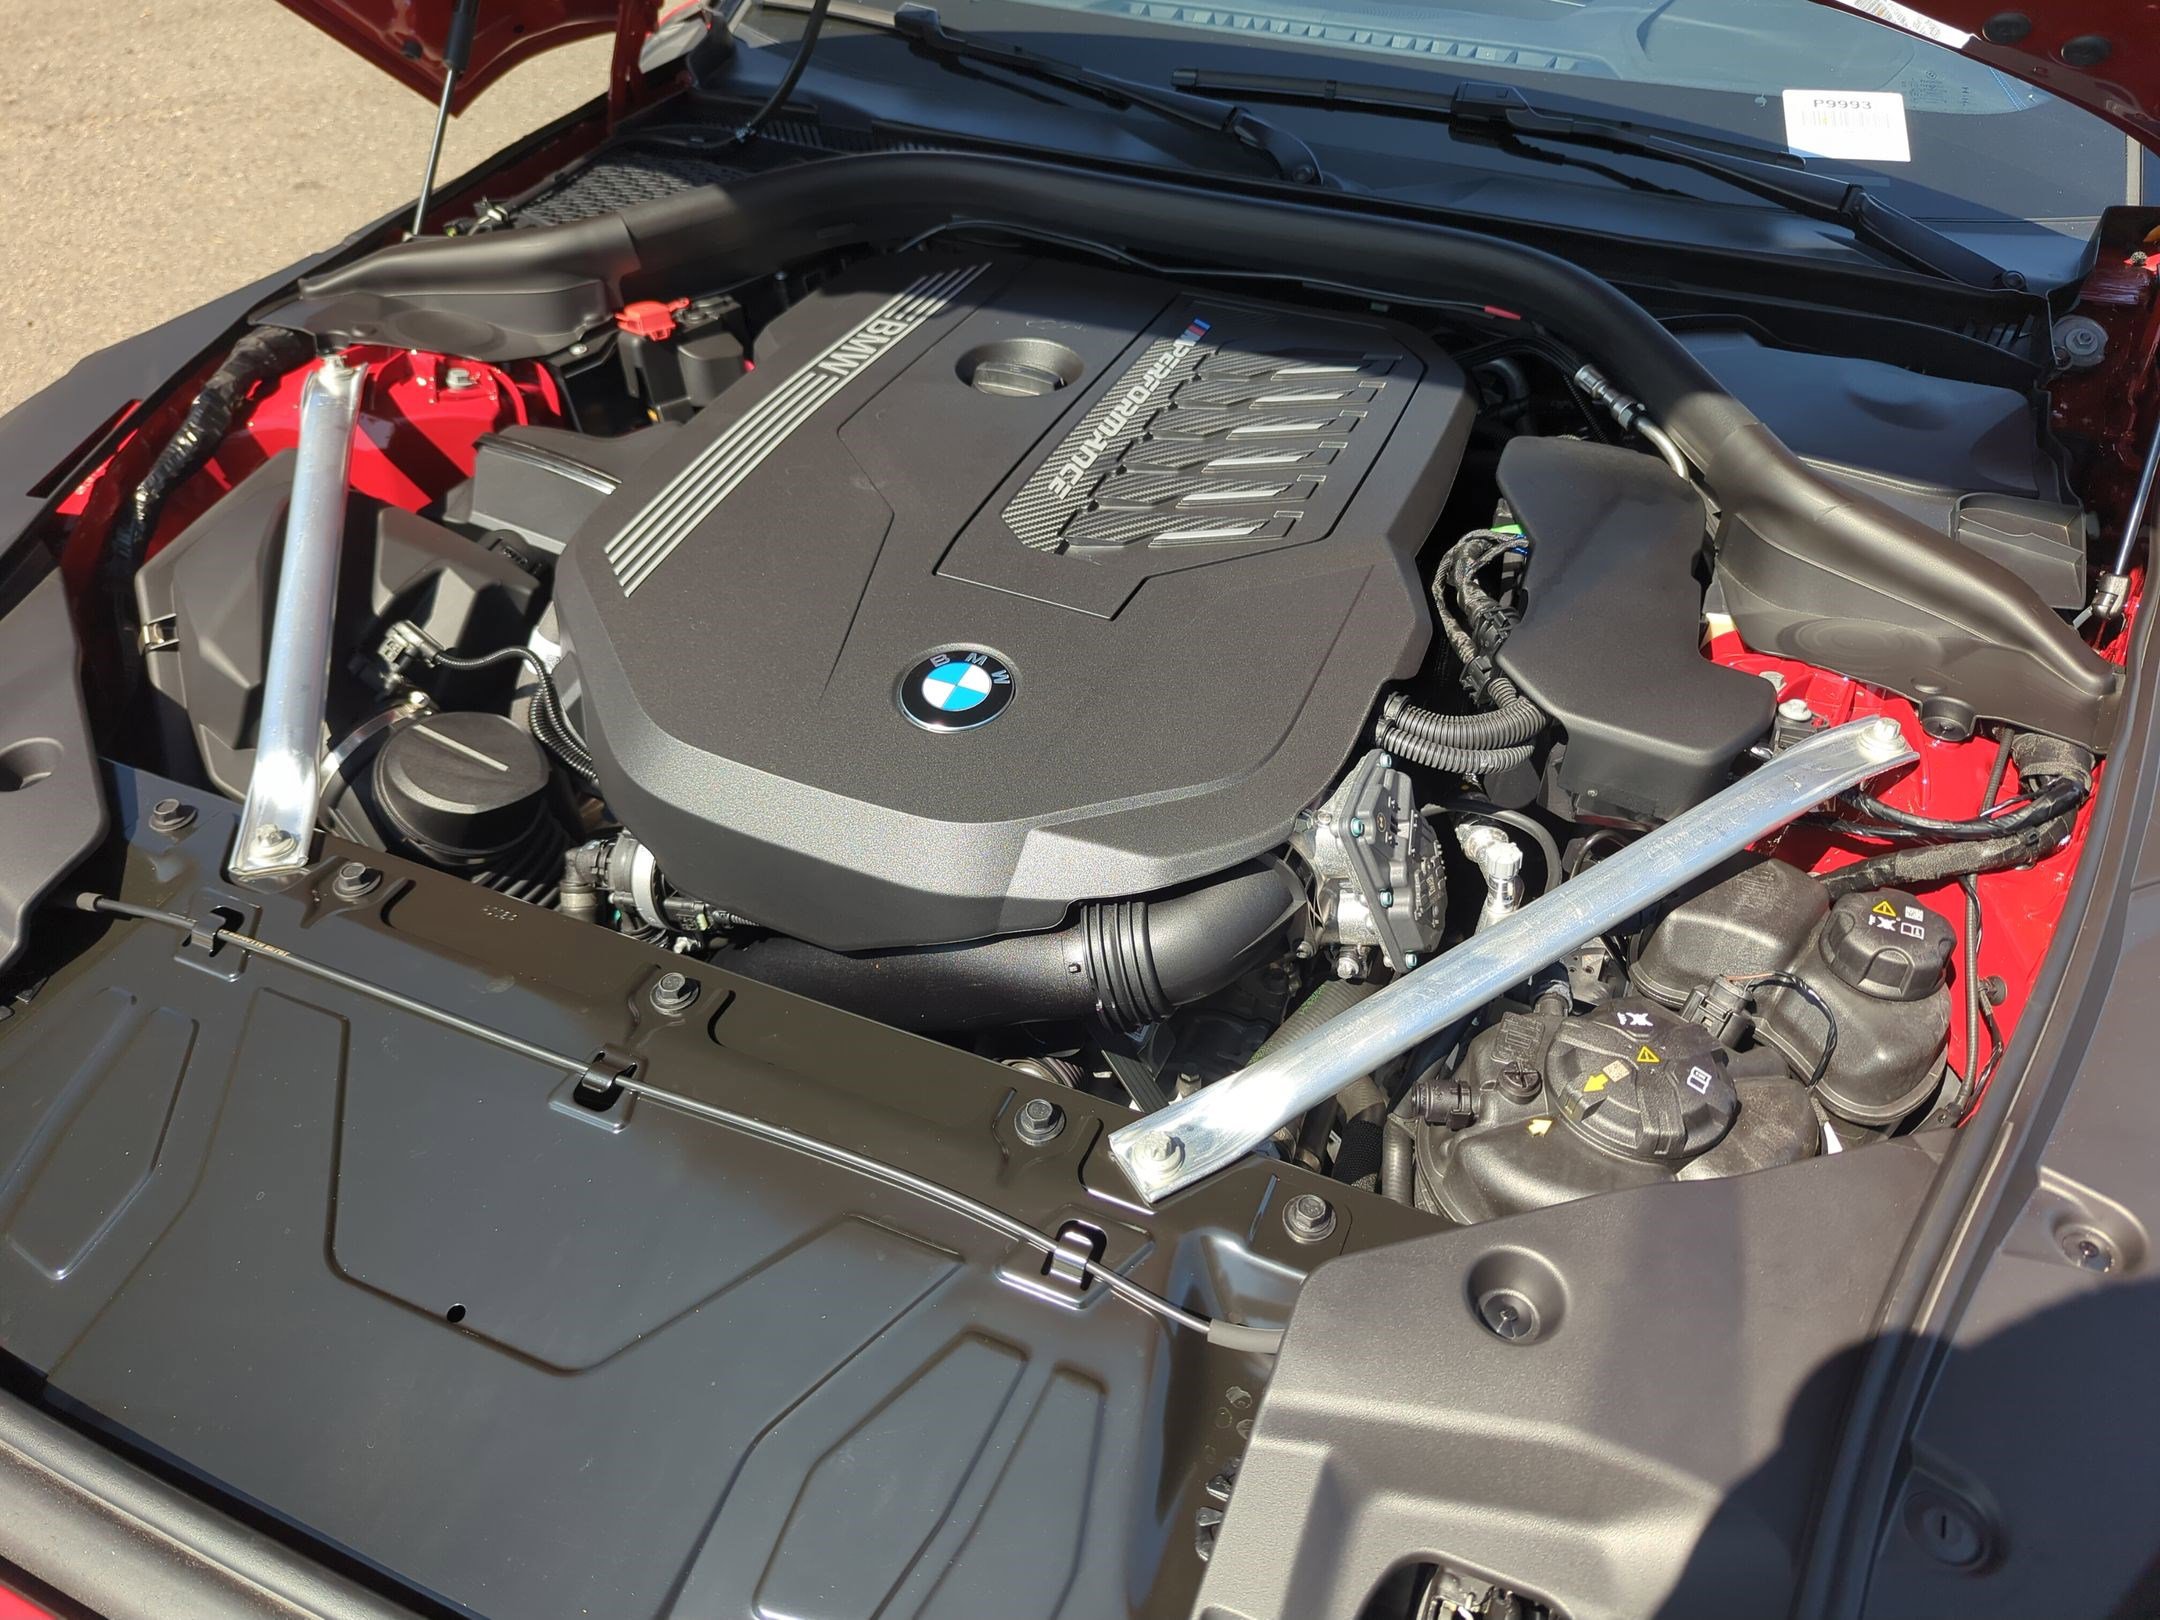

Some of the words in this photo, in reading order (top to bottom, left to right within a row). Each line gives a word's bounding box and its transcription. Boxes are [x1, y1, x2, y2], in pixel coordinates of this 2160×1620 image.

[1813, 99, 1872, 110] P9993
[818, 319, 909, 376] BMW
[1048, 344, 1192, 500] PERFORMANCE
[929, 652, 1011, 685] BMW
